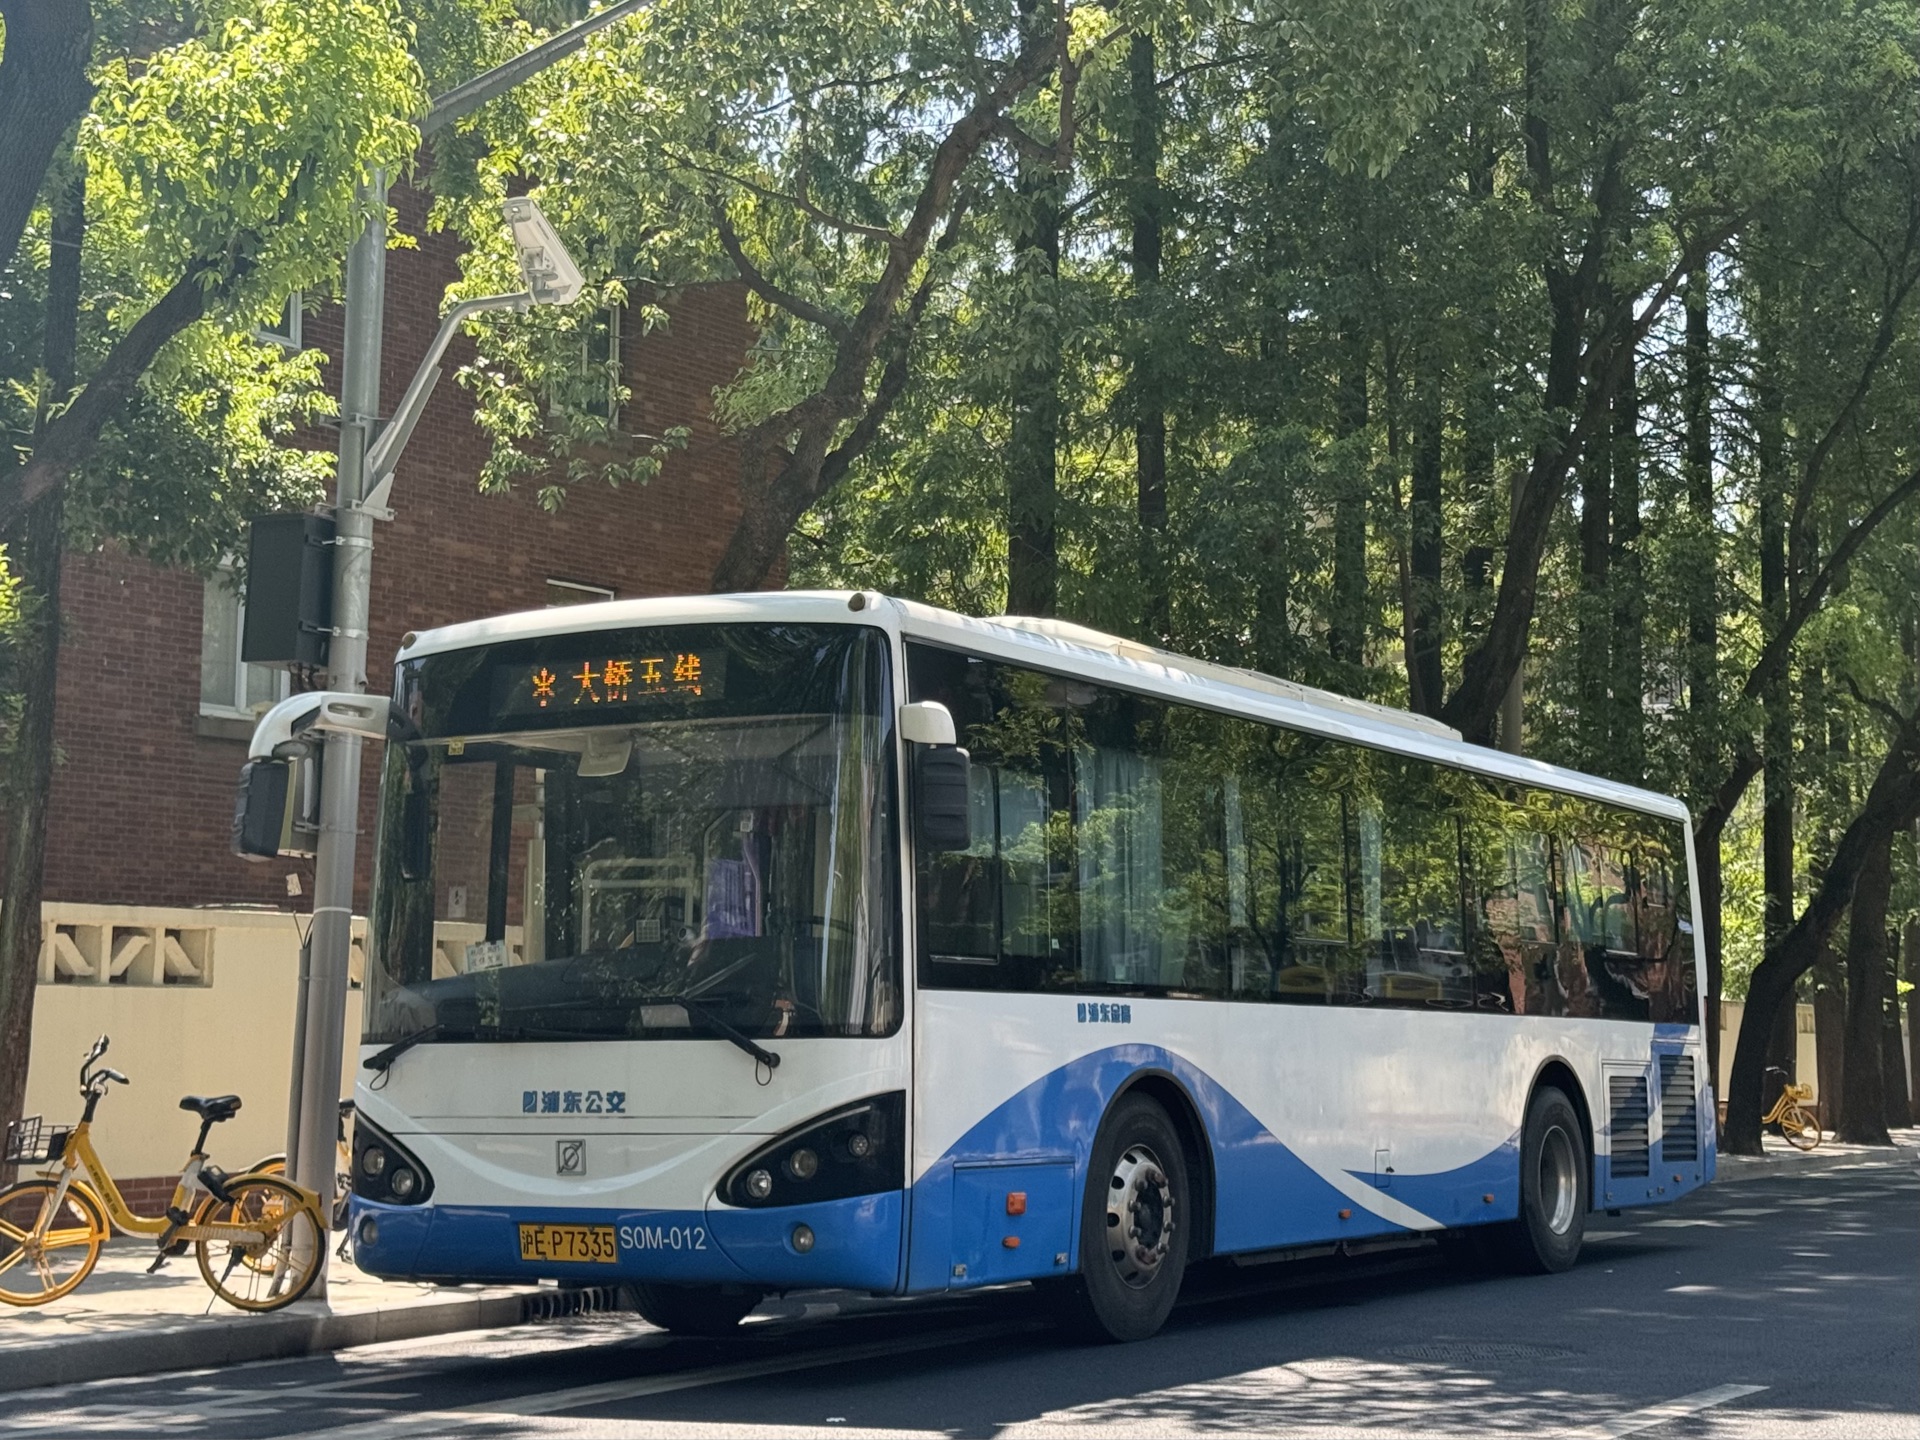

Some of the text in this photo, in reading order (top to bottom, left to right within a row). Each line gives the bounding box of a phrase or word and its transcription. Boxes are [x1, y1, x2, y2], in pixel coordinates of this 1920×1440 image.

[572, 653, 702, 704] 大桥五线
[541, 1090, 626, 1113] 浦东公交
